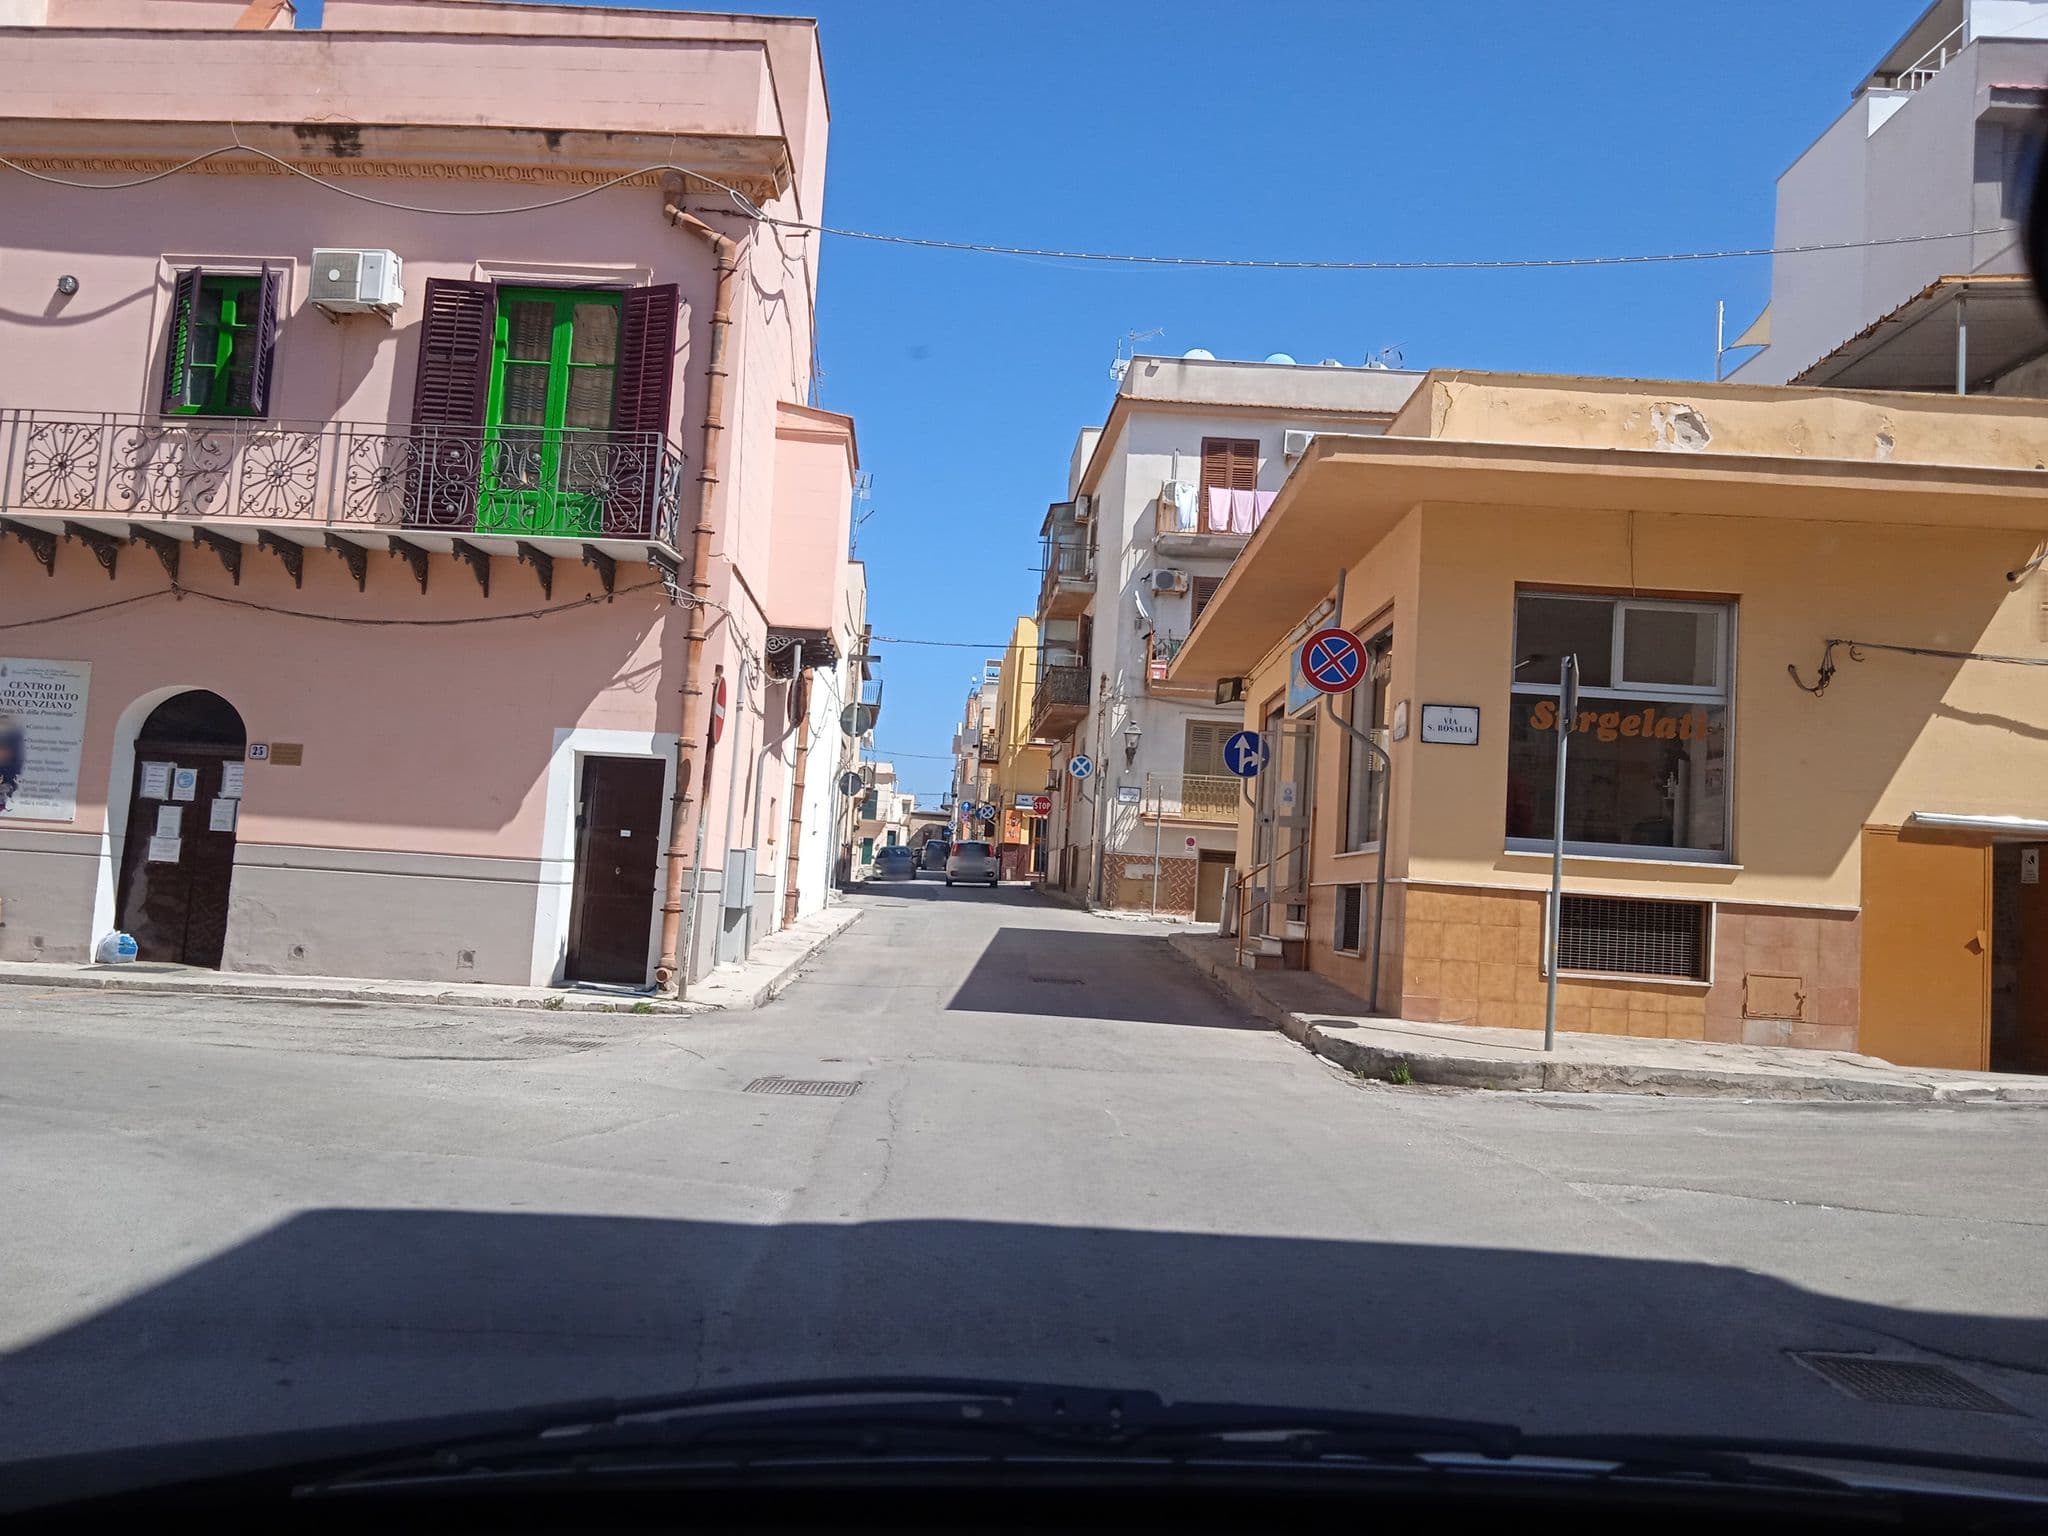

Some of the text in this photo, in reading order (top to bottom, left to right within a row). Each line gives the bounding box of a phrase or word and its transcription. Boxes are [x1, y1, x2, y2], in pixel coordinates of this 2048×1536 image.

[9, 681, 65, 692] CENTRO DI
[0, 689, 79, 701] OLONTARIATO
[1443, 717, 1457, 725] VIA
[1438, 724, 1472, 733] ROSALIA
[1034, 801, 1051, 810] STOP
